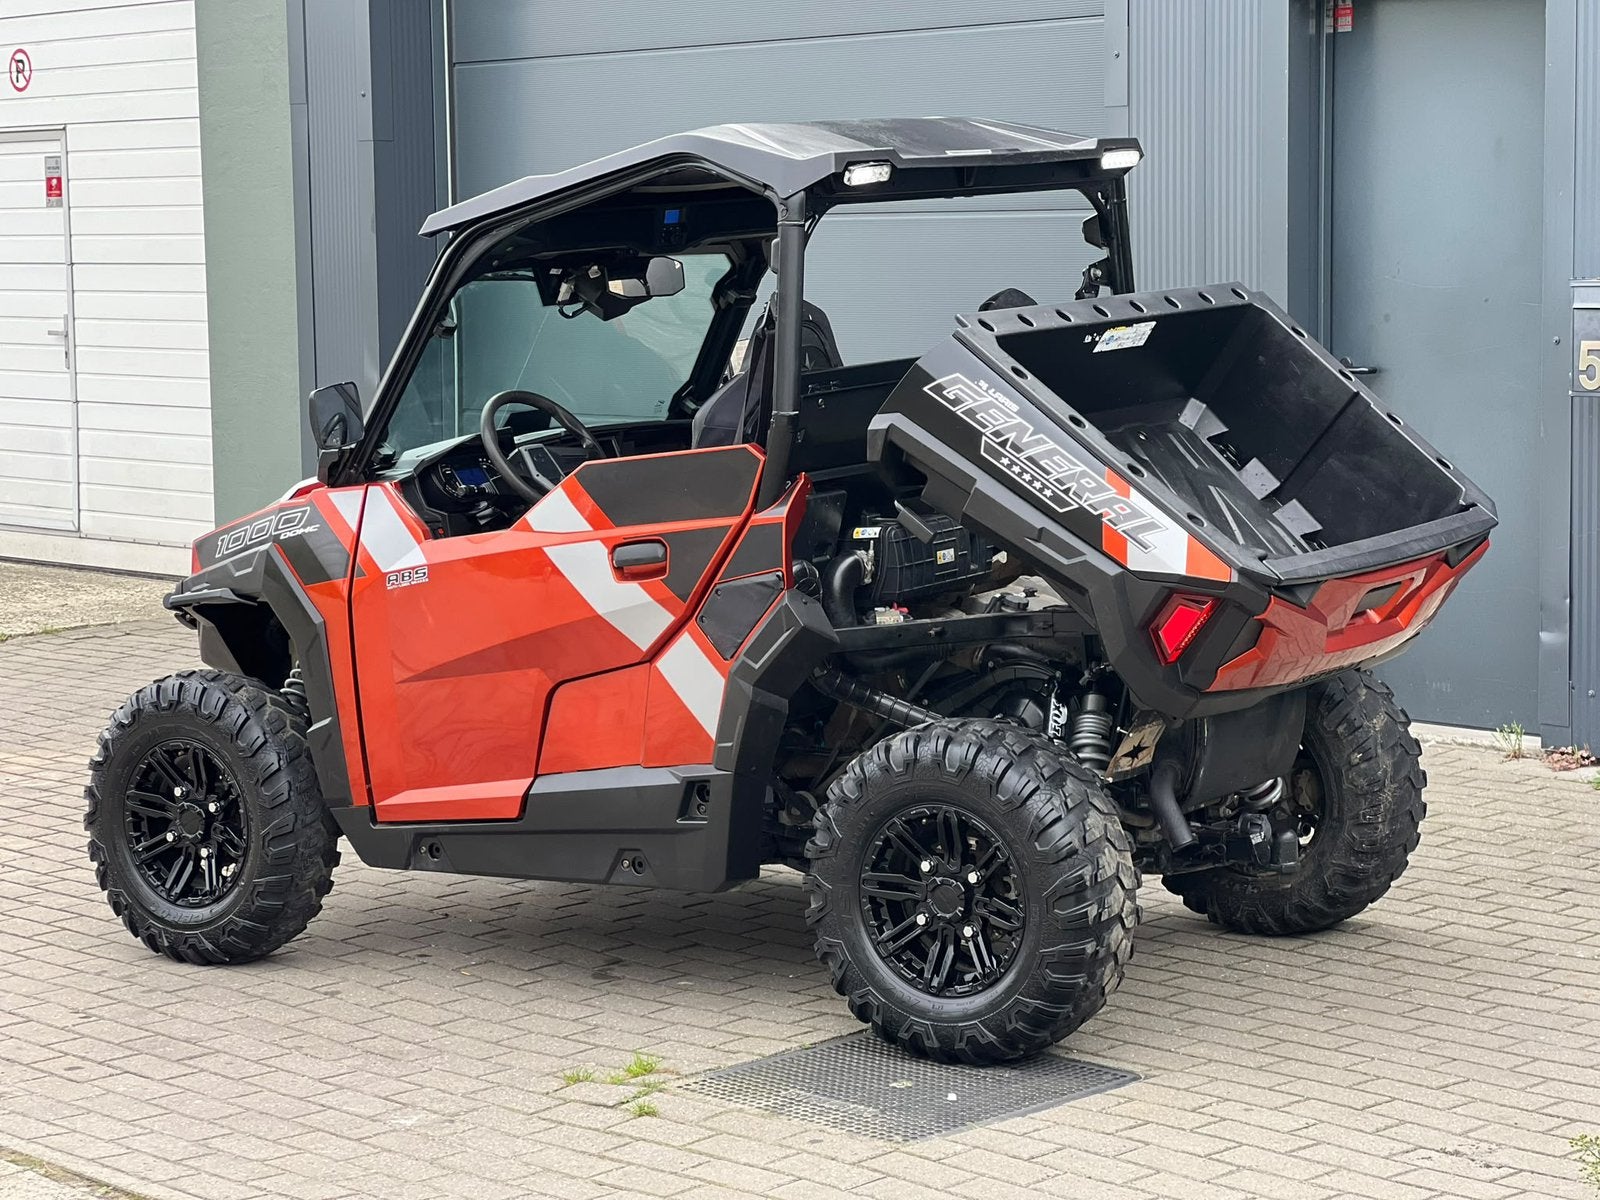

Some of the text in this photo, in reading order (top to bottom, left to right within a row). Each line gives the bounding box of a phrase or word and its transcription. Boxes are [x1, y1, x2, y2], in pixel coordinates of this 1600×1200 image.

[1579, 340, 1600, 391] 5
[923, 373, 1168, 554] GENERAL
[215, 506, 310, 558] 1000
[279, 524, 320, 540] DOHC
[386, 565, 428, 587] ABS
[1048, 698, 1068, 737] FOX
